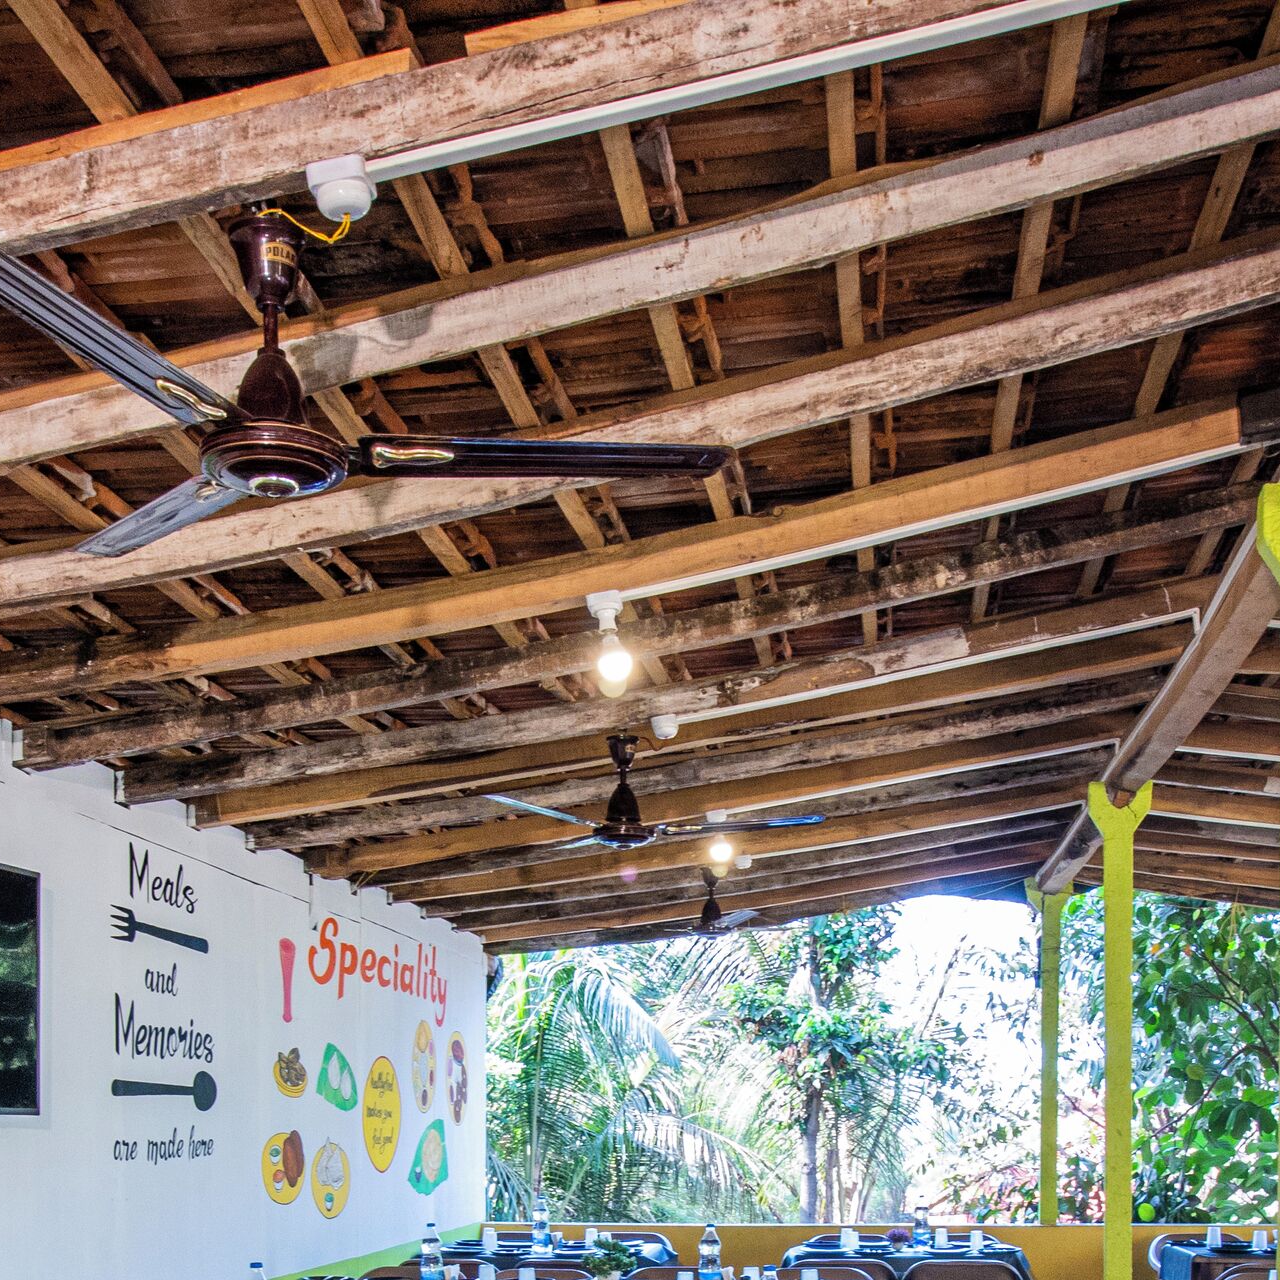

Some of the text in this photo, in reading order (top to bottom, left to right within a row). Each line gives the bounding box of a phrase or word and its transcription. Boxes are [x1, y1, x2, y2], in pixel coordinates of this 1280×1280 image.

[128, 841, 199, 914] Meals
[144, 963, 179, 997] and
[307, 917, 448, 1028] Speciality
[114, 992, 216, 1064] Memories
[113, 1124, 215, 1166] are made here
